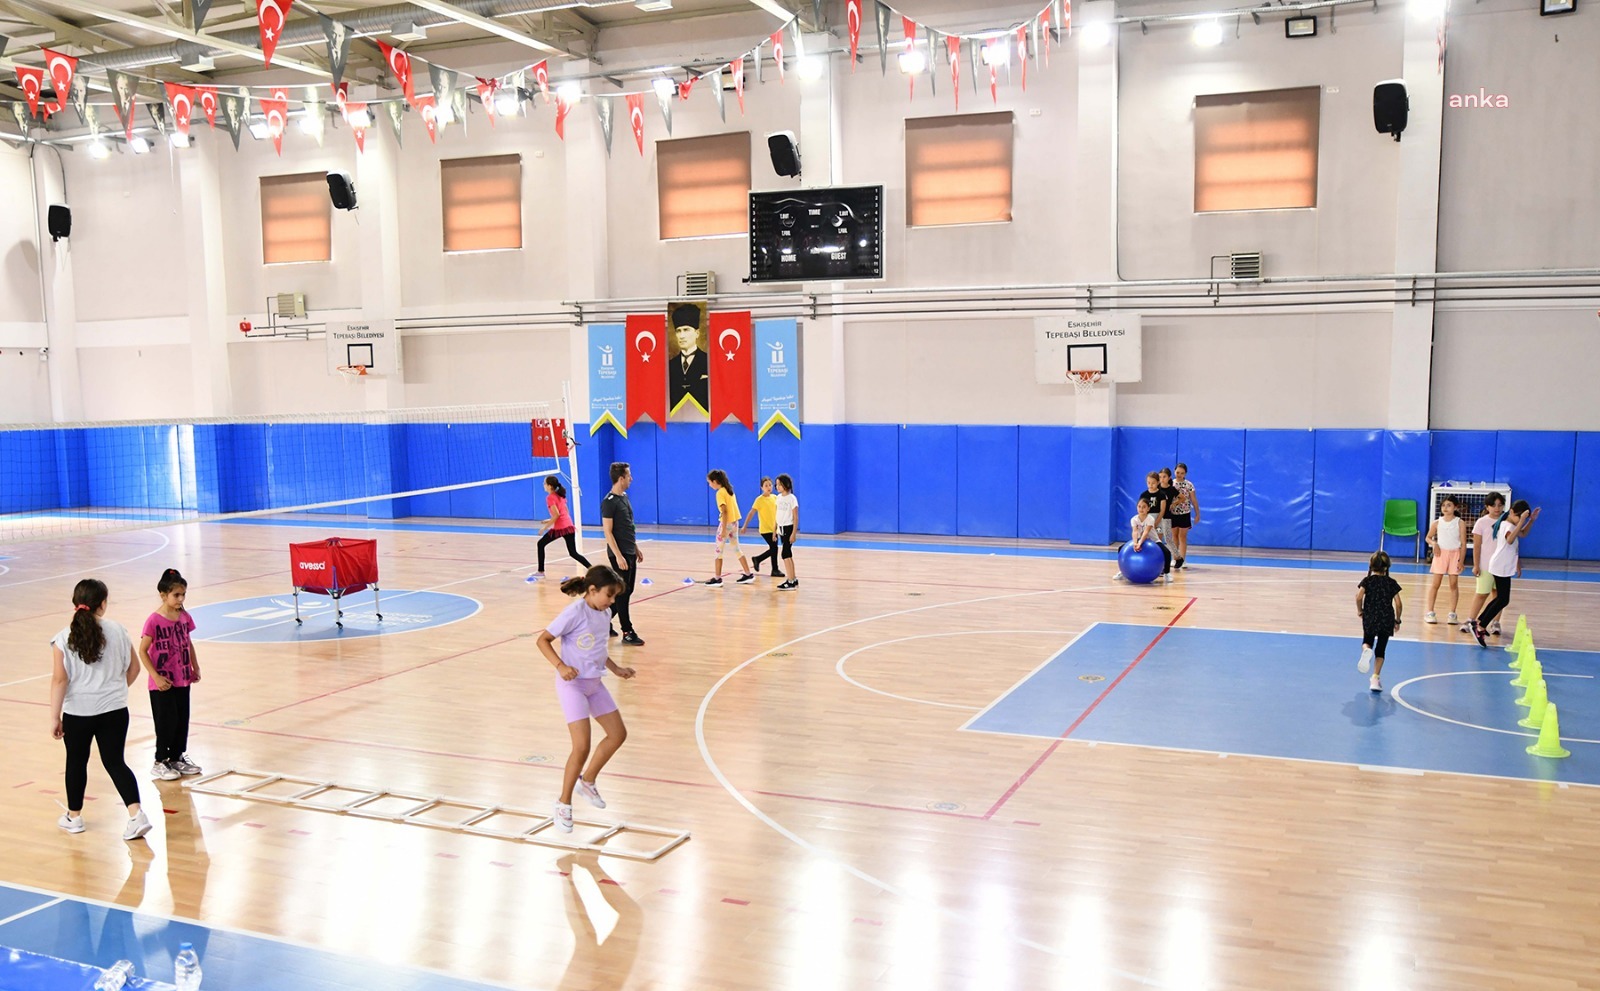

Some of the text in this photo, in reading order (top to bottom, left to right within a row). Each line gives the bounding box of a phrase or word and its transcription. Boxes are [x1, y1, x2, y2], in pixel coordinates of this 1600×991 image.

[780, 254, 796, 262] HOME
[830, 252, 846, 260] GUEST
[300, 562, 326, 570] avessa
